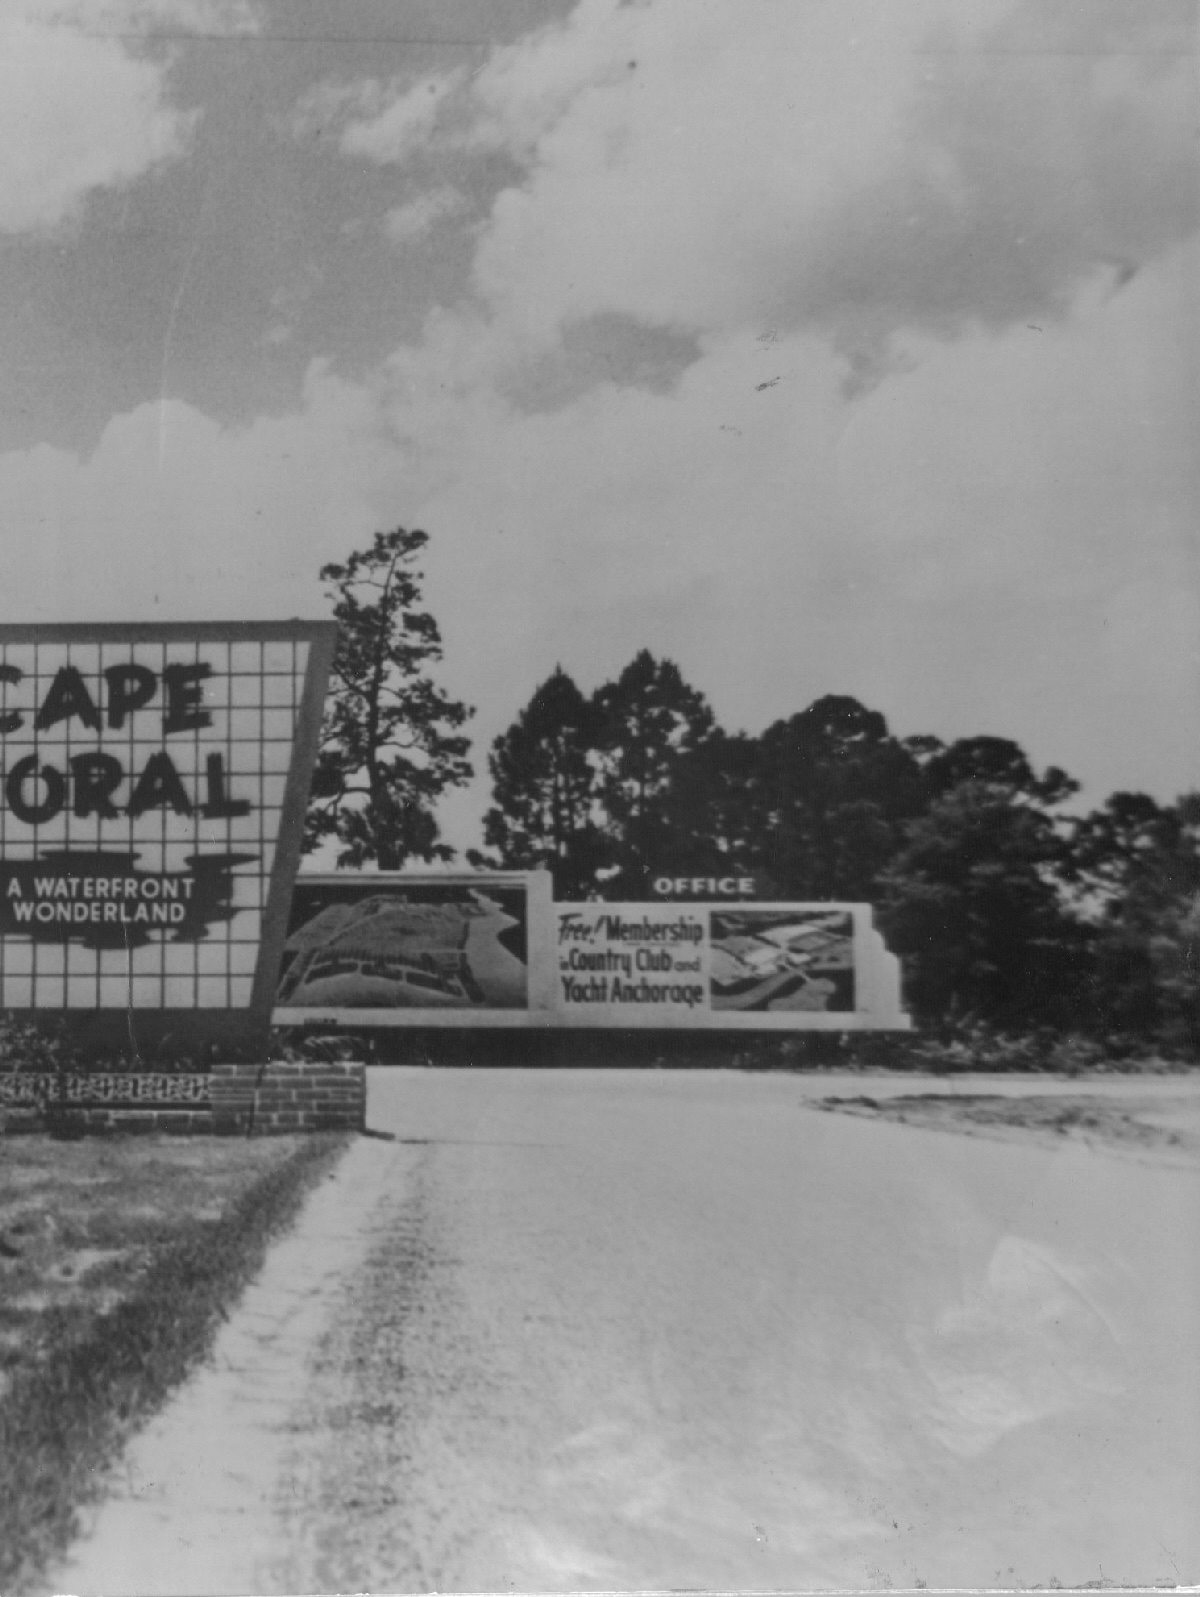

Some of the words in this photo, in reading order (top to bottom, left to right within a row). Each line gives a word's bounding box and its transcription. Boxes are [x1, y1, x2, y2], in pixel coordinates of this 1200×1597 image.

[7, 876, 22, 898] A
[33, 876, 196, 899] WATERFRONT
[653, 877, 755, 895] OFFICE
[12, 901, 186, 923] WONDERLAND
[557, 912, 608, 945] Free!
[605, 914, 703, 946] Membership
[568, 948, 633, 979] Country
[635, 948, 673, 972] Club
[560, 975, 607, 1003] Yacht
[609, 975, 703, 1009] Anchorage
